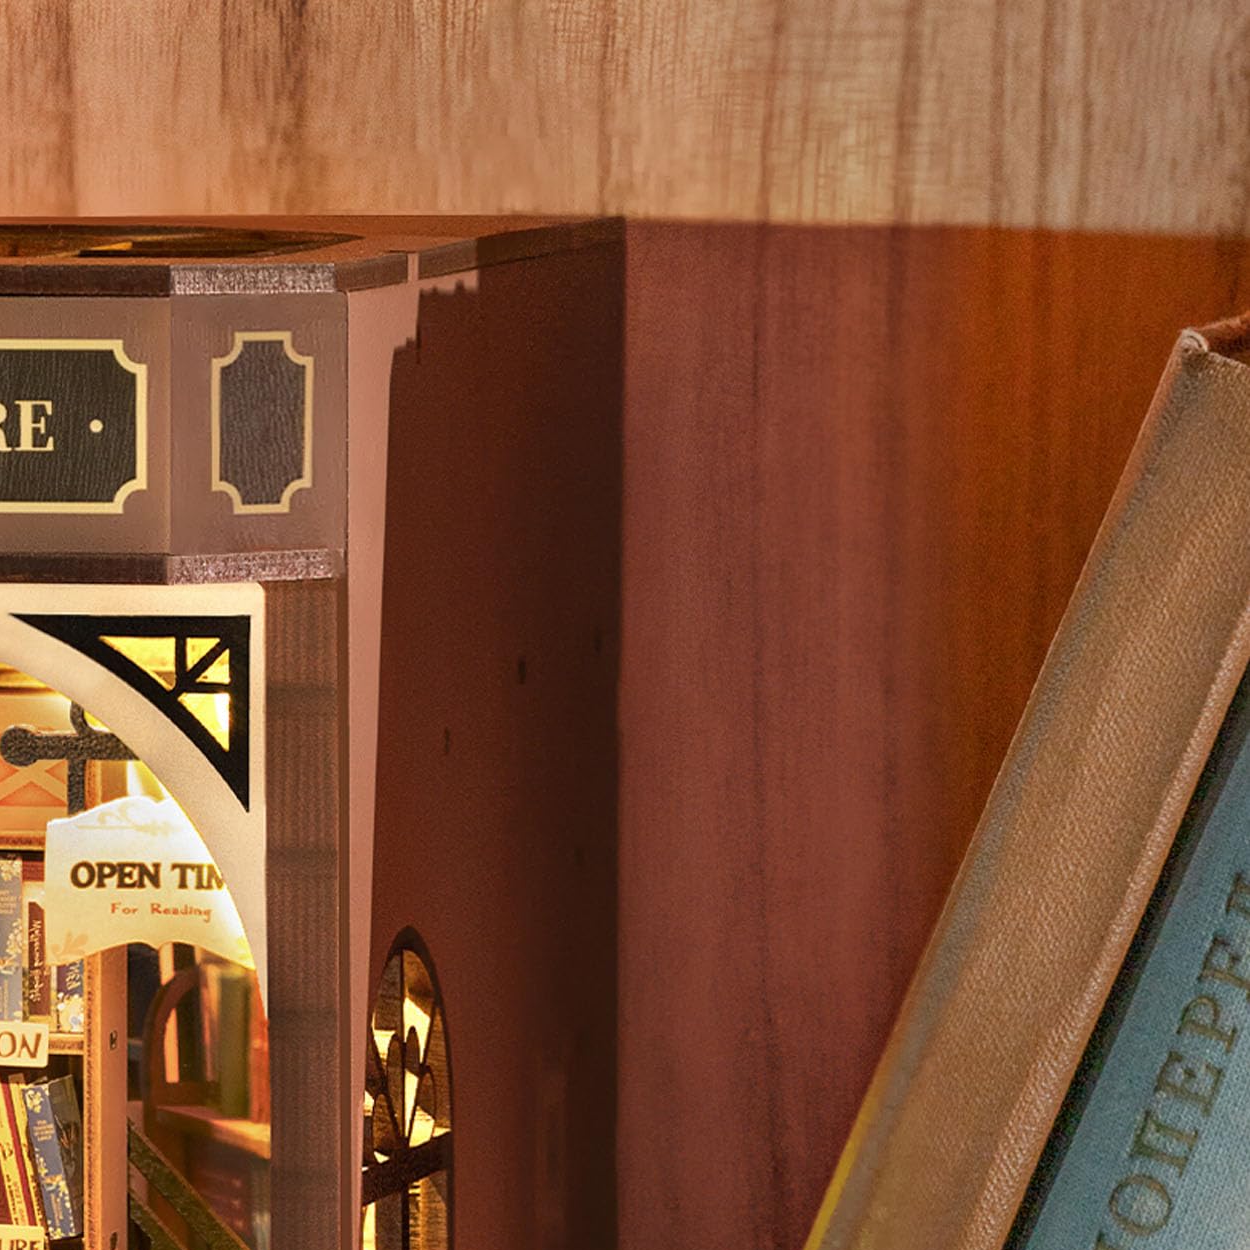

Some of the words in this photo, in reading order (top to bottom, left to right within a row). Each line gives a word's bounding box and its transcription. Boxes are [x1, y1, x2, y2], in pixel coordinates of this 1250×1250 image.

[69, 860, 162, 890] OPEN
[110, 902, 139, 915] For
[150, 902, 213, 923] Reading
